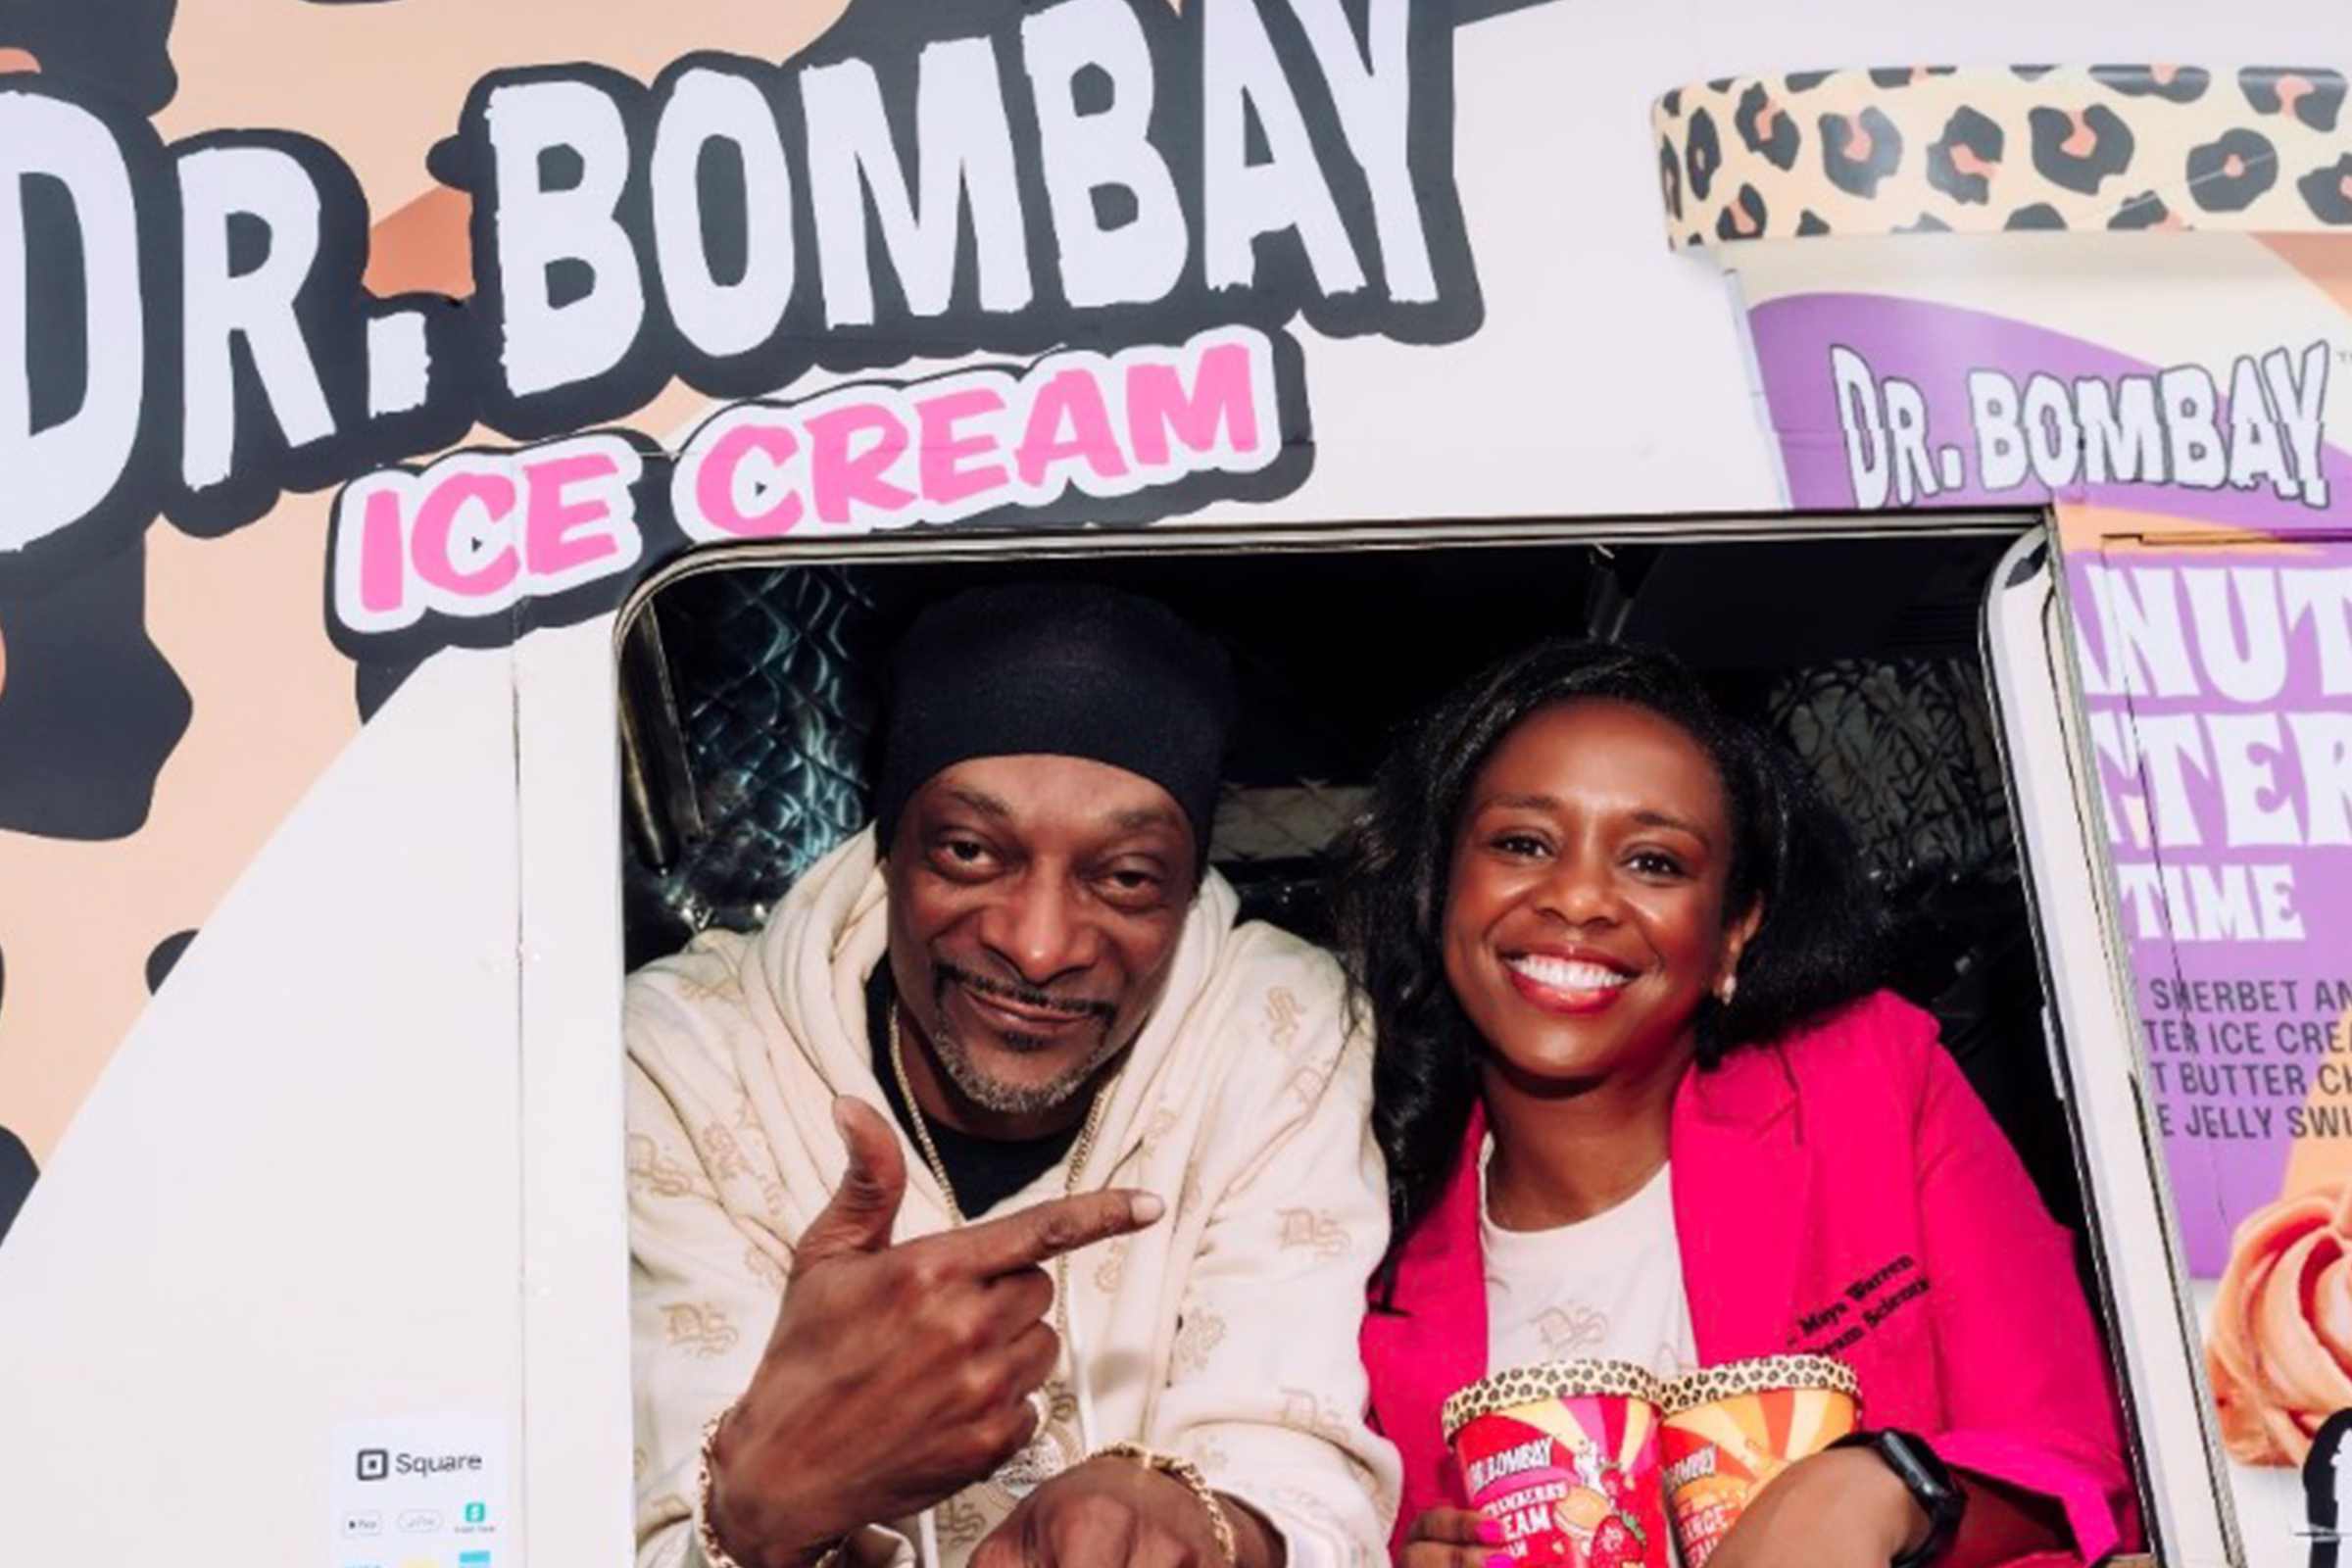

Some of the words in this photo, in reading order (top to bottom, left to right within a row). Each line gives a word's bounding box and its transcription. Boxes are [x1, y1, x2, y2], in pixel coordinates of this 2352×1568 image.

[0, 90, 431, 554] DR.
[484, 0, 1439, 398] BOMBAY
[1830, 343, 1965, 510] DR.
[1967, 339, 2329, 510] BOMBAY
[359, 453, 621, 613] ICE
[695, 342, 1260, 538] CREAM
[2074, 565, 2352, 703] NUT
[2116, 863, 2307, 941] TIME
[2149, 977, 2299, 1013] SHERBET
[2142, 1019, 2200, 1054] TER
[2208, 1021, 2266, 1054] ICE
[2275, 1021, 2352, 1054] CRE
[2178, 1061, 2307, 1097] BUTTER
[2184, 1104, 2272, 1140] JELLY
[395, 1452, 483, 1478] Square
